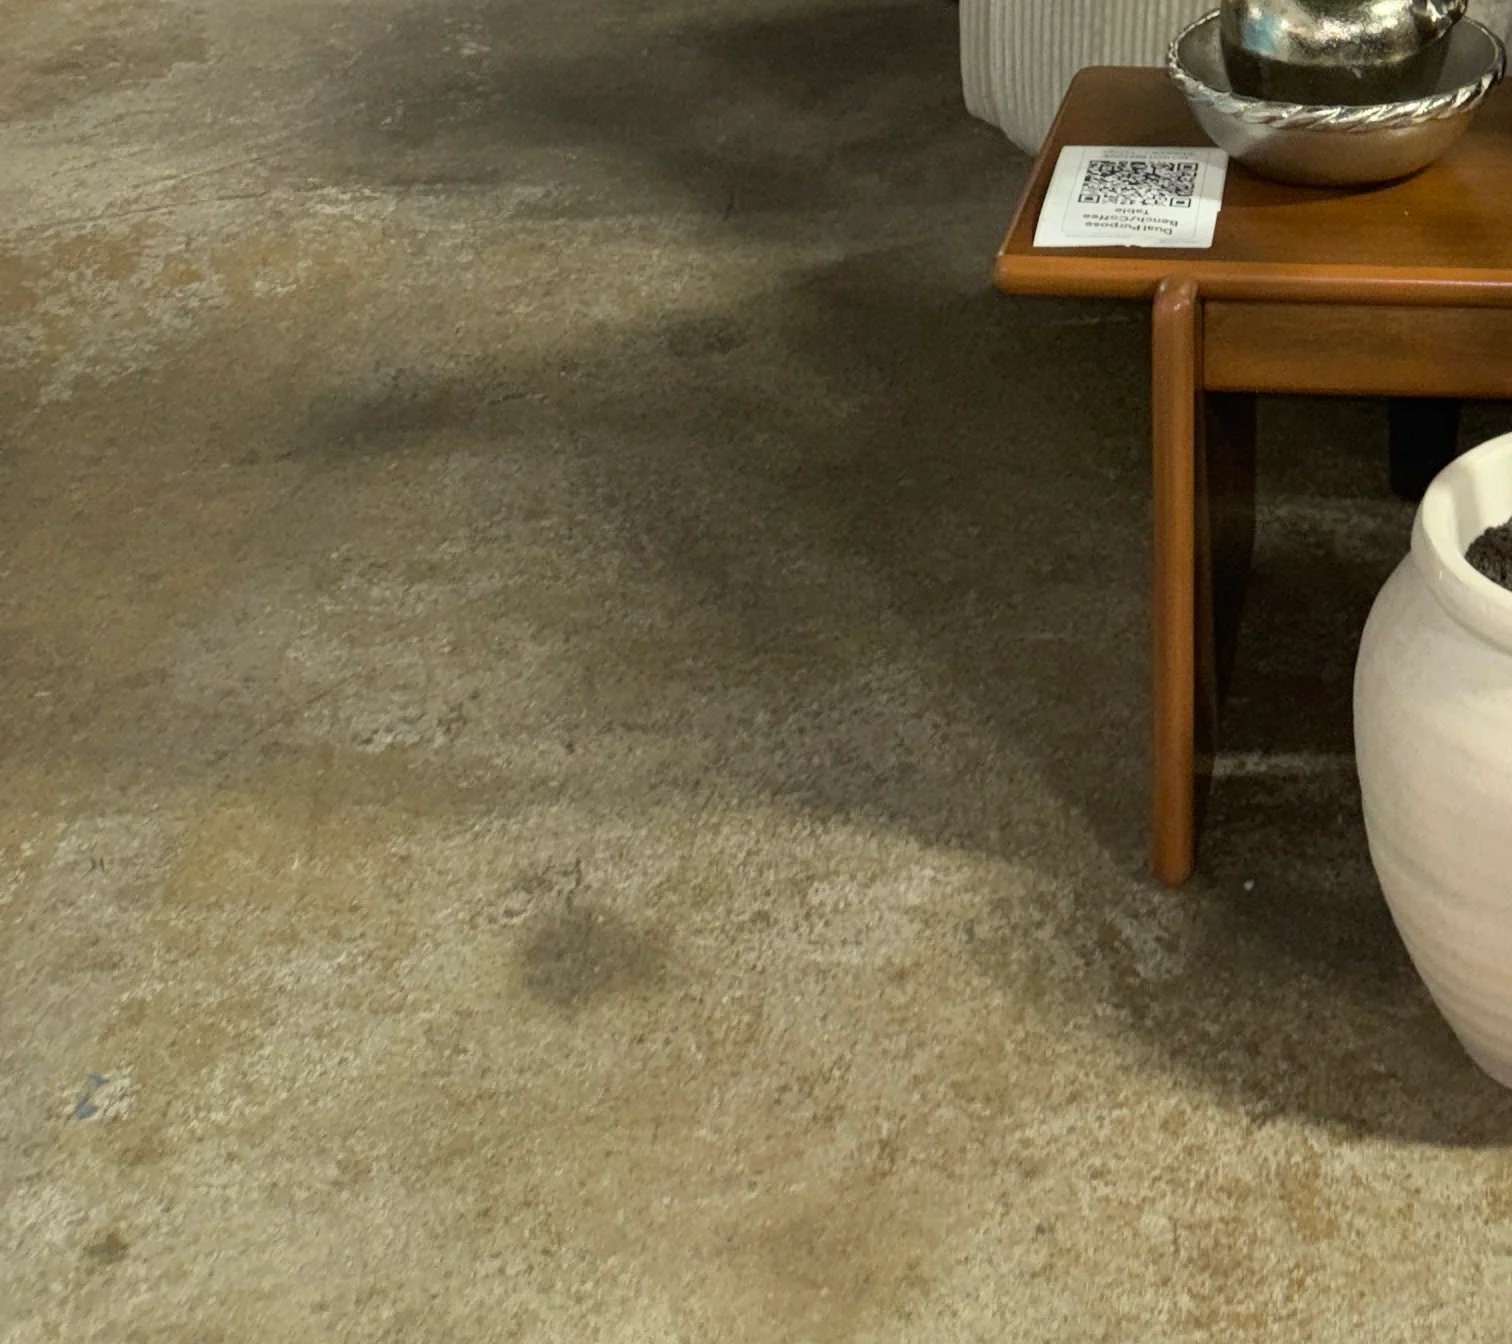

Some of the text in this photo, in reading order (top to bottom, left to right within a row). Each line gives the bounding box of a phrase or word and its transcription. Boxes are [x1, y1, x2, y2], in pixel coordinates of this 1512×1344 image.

[1083, 214, 1178, 227] Bench/Coffee
[1085, 222, 1173, 235] Dual Purpose
